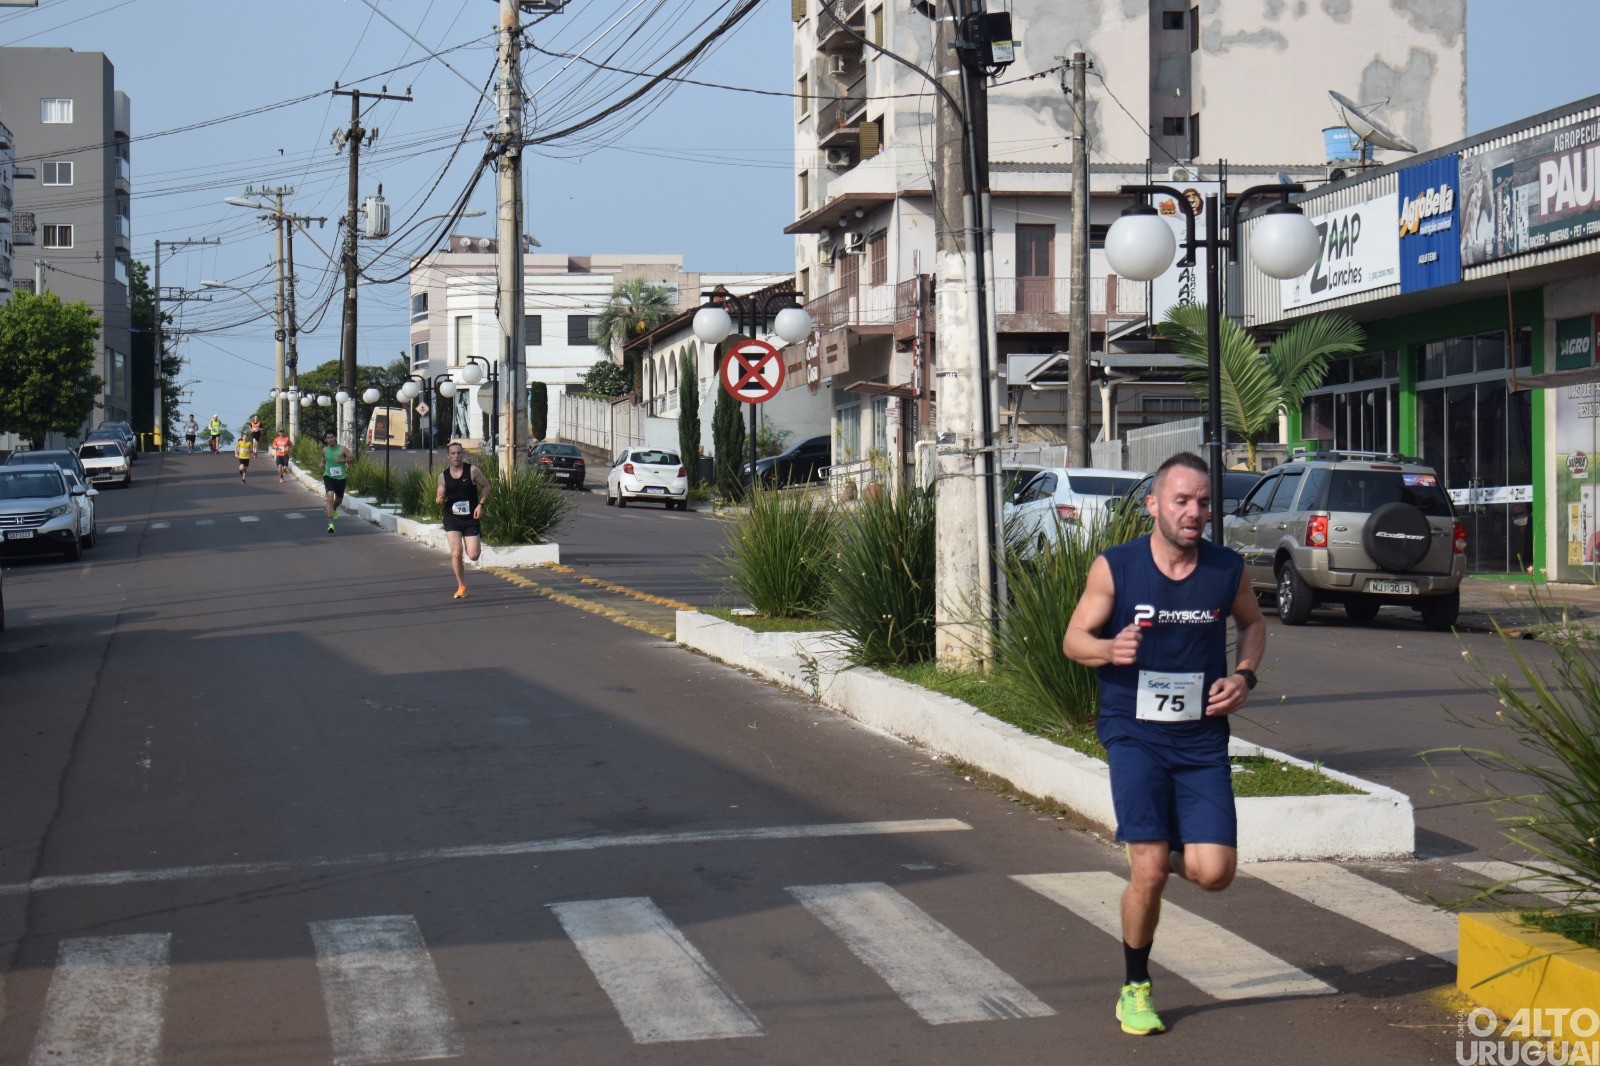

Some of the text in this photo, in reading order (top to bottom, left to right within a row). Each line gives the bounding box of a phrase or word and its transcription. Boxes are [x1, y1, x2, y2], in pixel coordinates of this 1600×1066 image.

[1399, 184, 1454, 237] AgroBella
[1574, 224, 1582, 237] PET
[1310, 212, 1361, 295] ZAAP
[1329, 262, 1362, 291] Lanches
[1561, 336, 1590, 356] AGRO
[1568, 457, 1586, 469] SUPRA
[1158, 610, 1214, 621] PHYSICAL
[1154, 694, 1185, 712] 75
